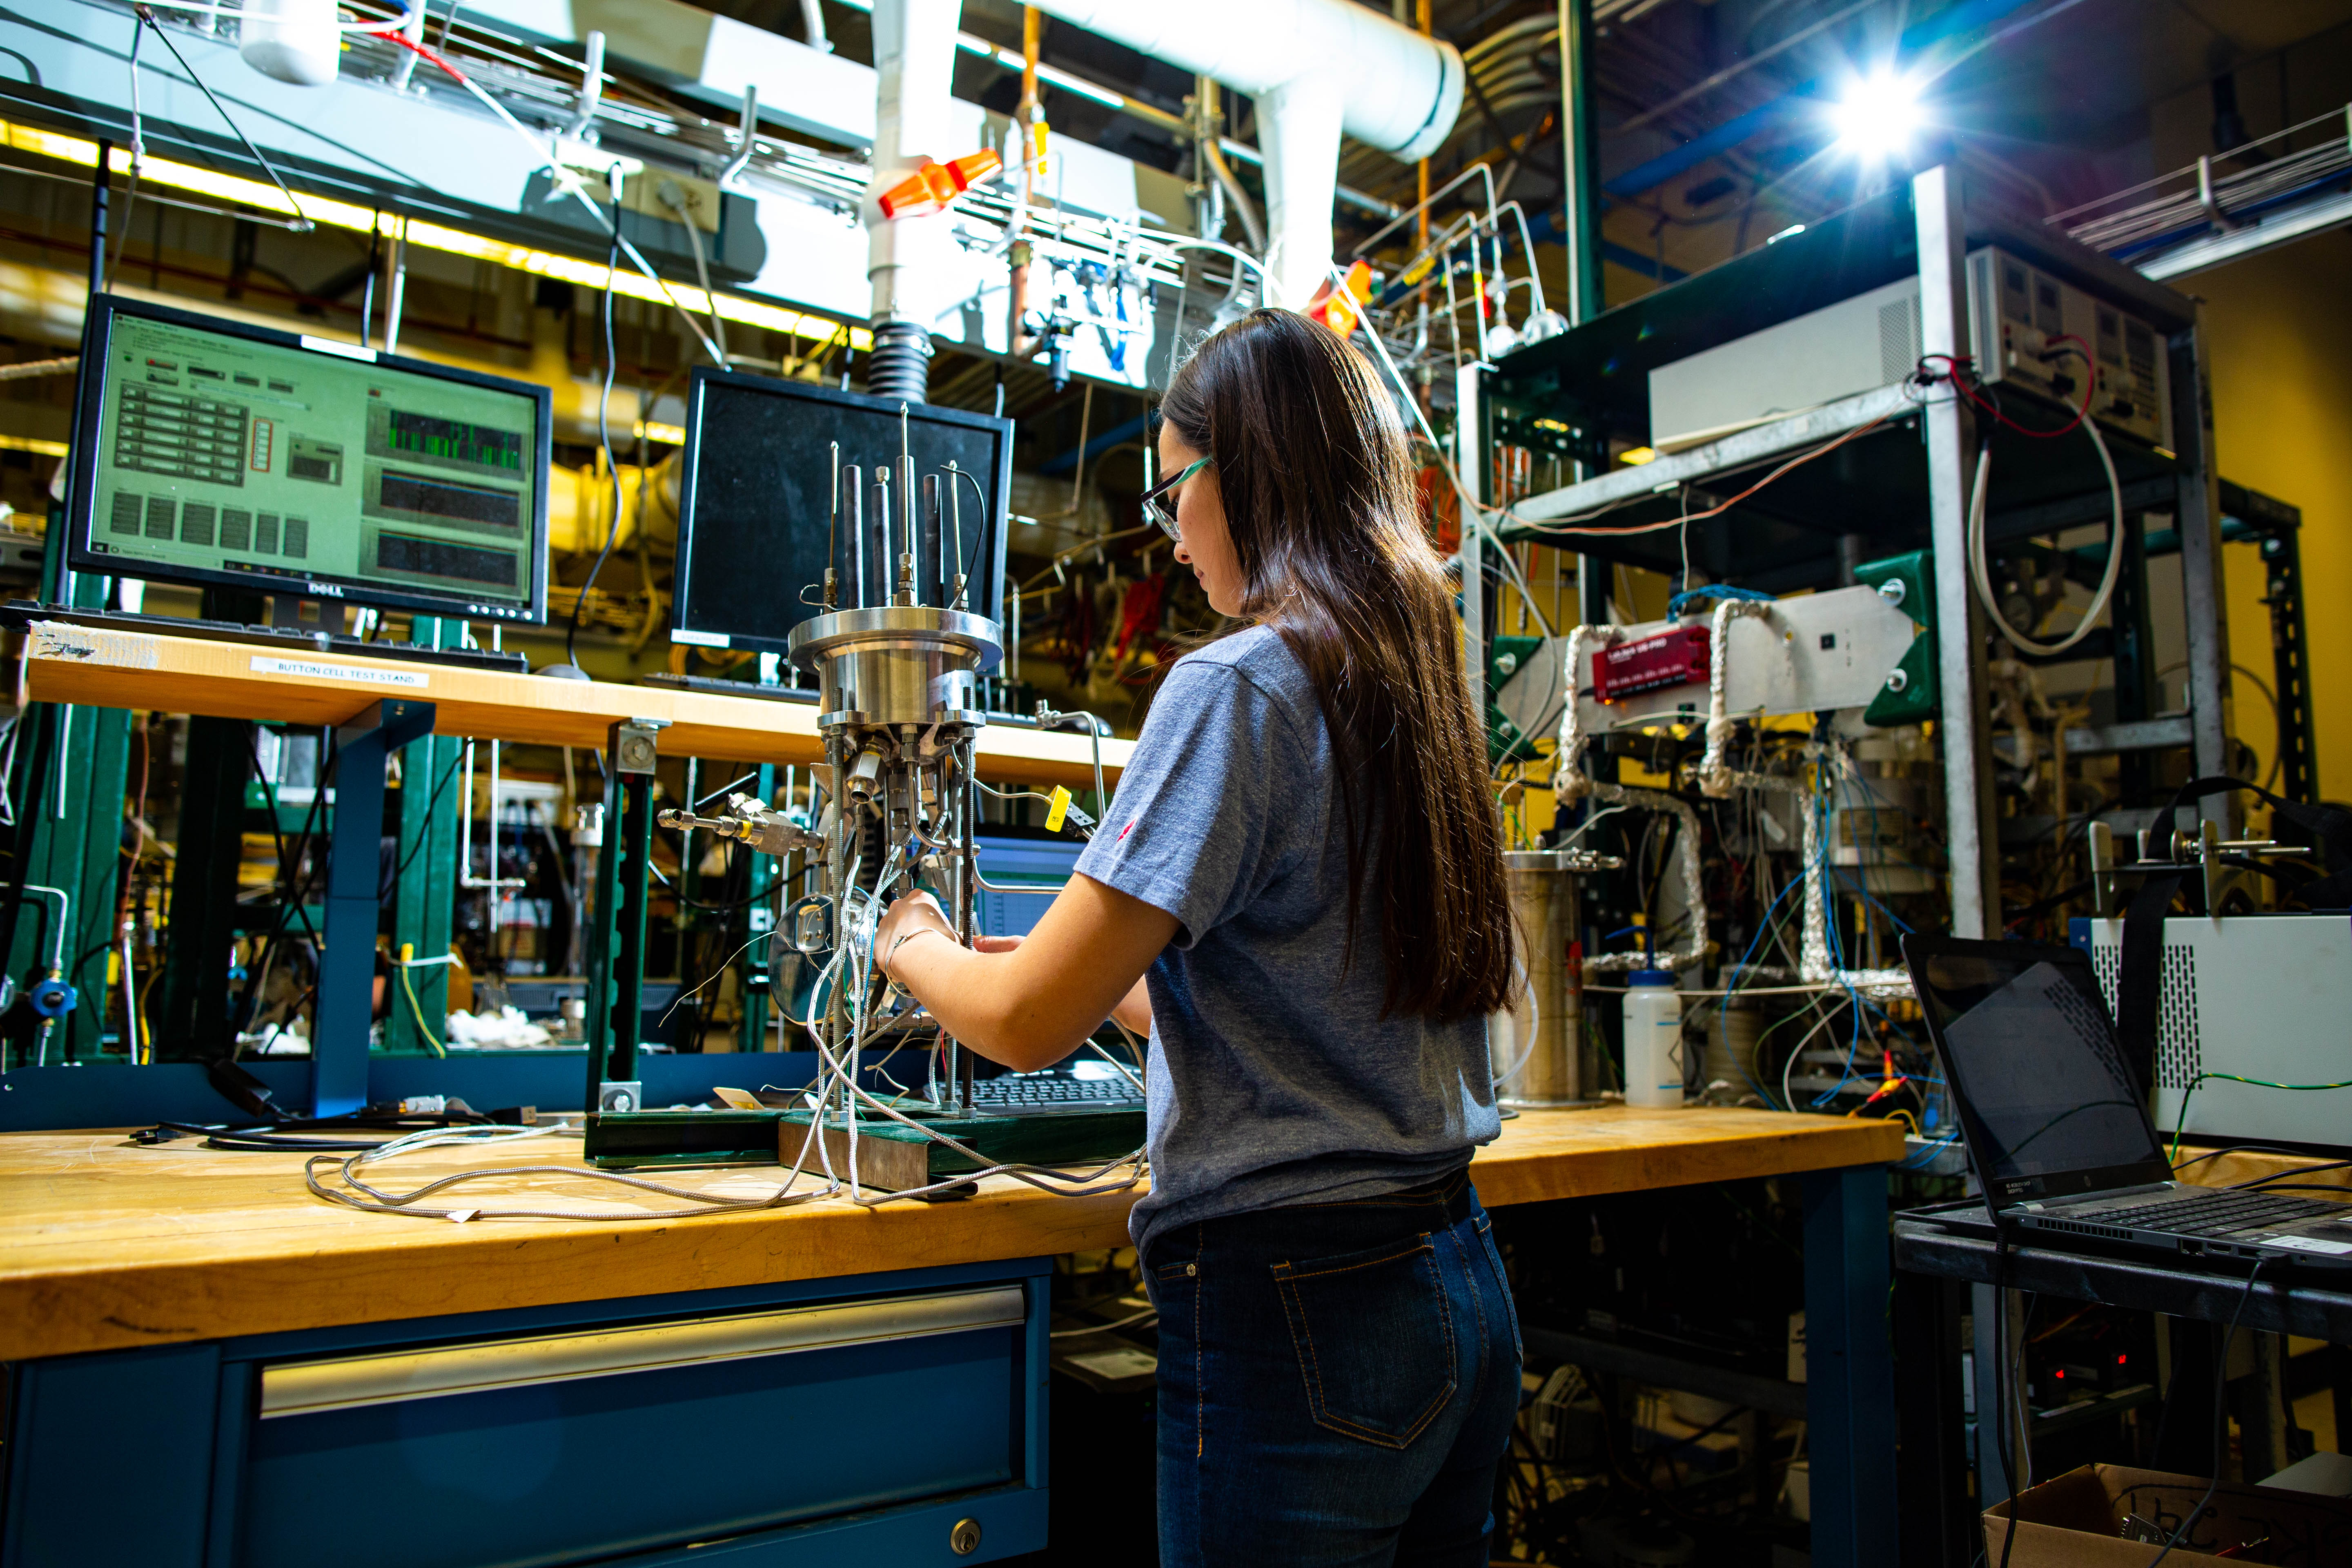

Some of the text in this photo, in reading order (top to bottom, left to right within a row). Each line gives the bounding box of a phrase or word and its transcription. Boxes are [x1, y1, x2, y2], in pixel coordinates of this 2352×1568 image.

[308, 583, 344, 597] DELL
[278, 663, 414, 683] BUTTON CELL TEST STAND
